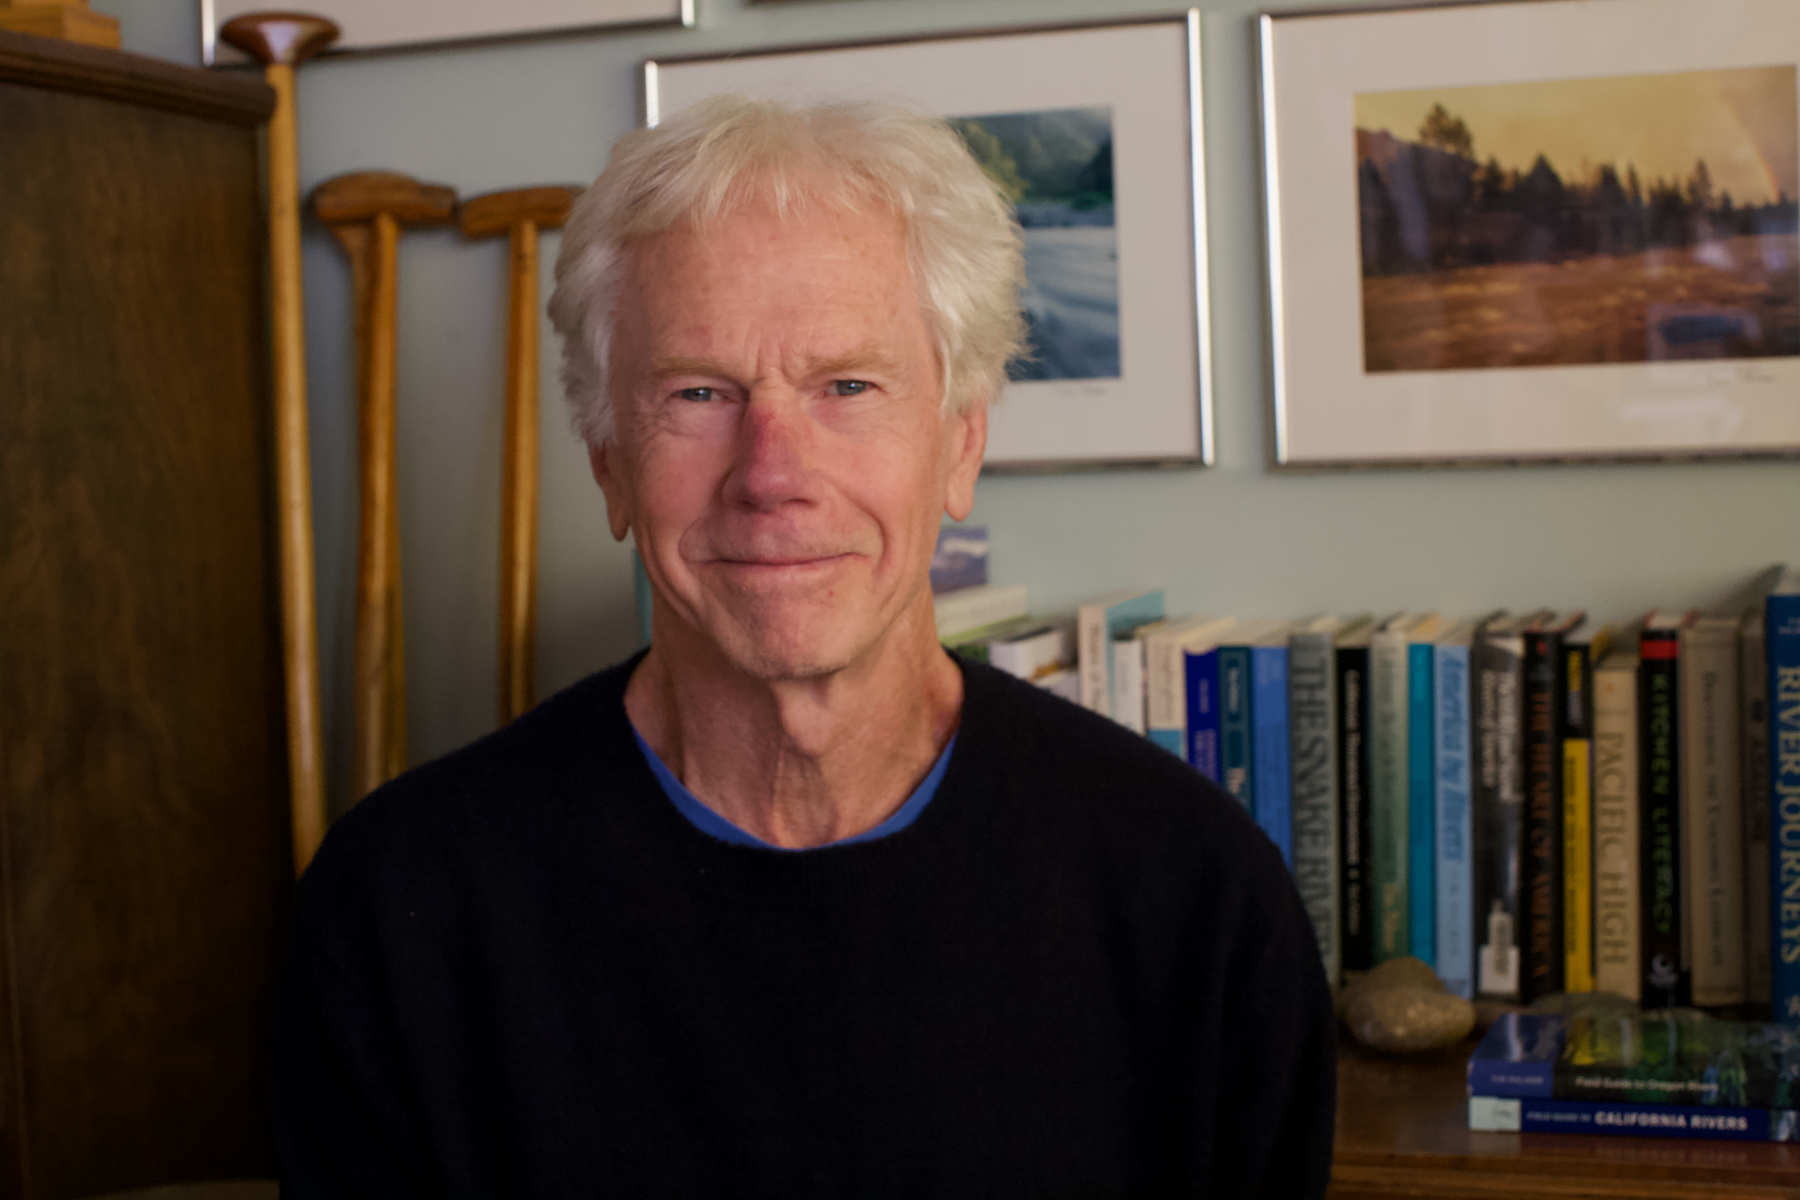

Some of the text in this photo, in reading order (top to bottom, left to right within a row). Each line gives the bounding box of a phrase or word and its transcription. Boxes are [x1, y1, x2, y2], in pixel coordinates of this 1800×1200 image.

[1294, 657, 1328, 731] THE
[1292, 734, 1331, 848] SNAKE
[1597, 731, 1629, 964] PACIFIC HIGH
[1652, 673, 1673, 935] KITCHEN LITERACY
[1775, 666, 1800, 964] RIVER JOURNEYS
[1594, 1110, 1687, 1129] CALIFORNIA
[1690, 1114, 1748, 1131] RIVERS
